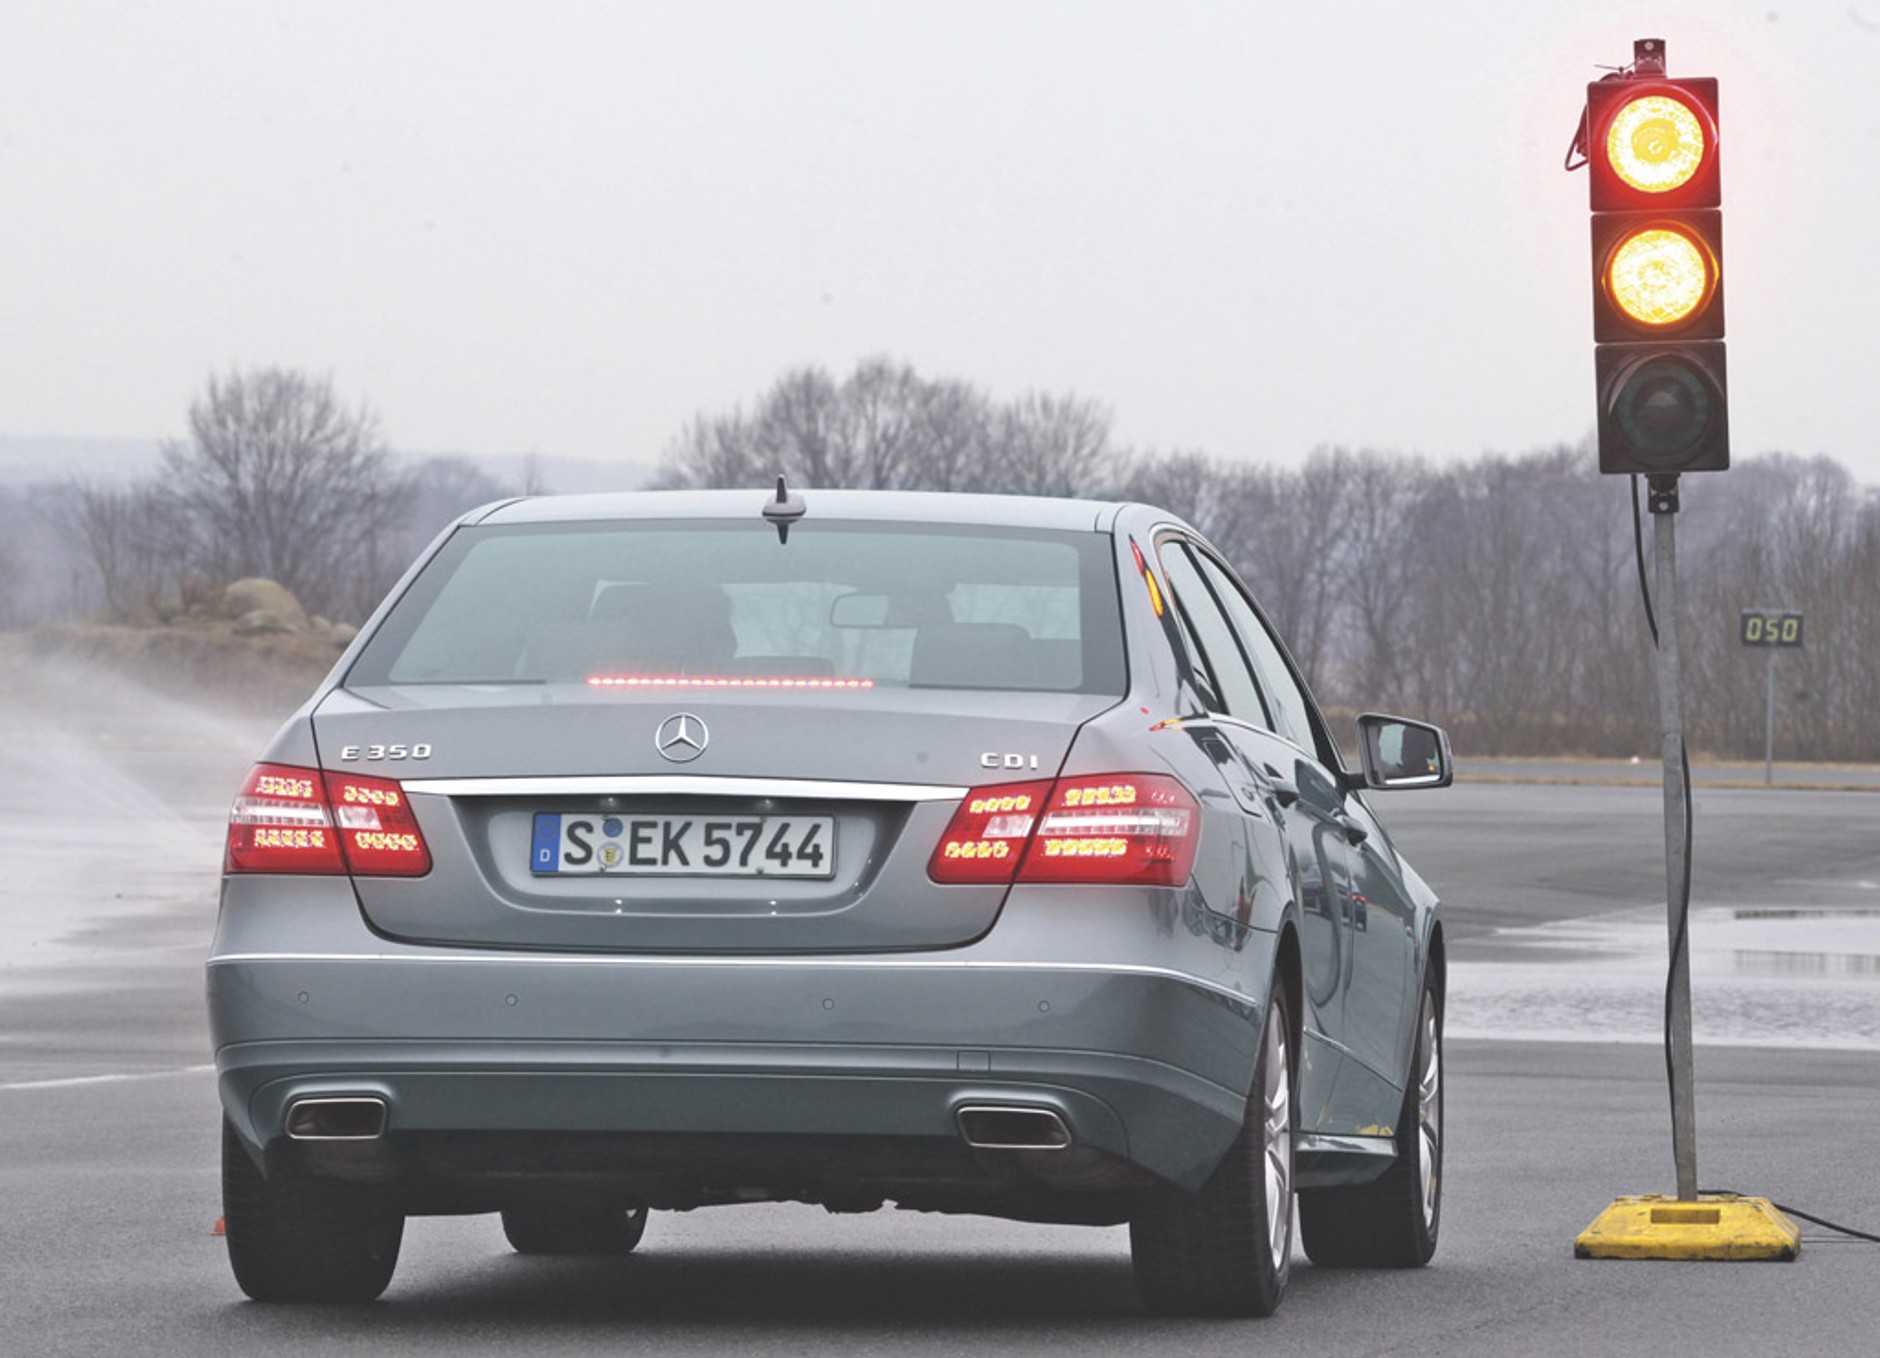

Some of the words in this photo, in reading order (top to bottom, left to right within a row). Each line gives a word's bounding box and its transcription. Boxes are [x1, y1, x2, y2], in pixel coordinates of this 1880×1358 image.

[1746, 617, 1798, 642] 050
[341, 746, 360, 761] E
[366, 744, 432, 761] 350
[980, 752, 1038, 770] CDI
[563, 820, 594, 866] S
[628, 820, 693, 867] EK
[703, 822, 824, 868] 5744
[539, 848, 550, 862] D
